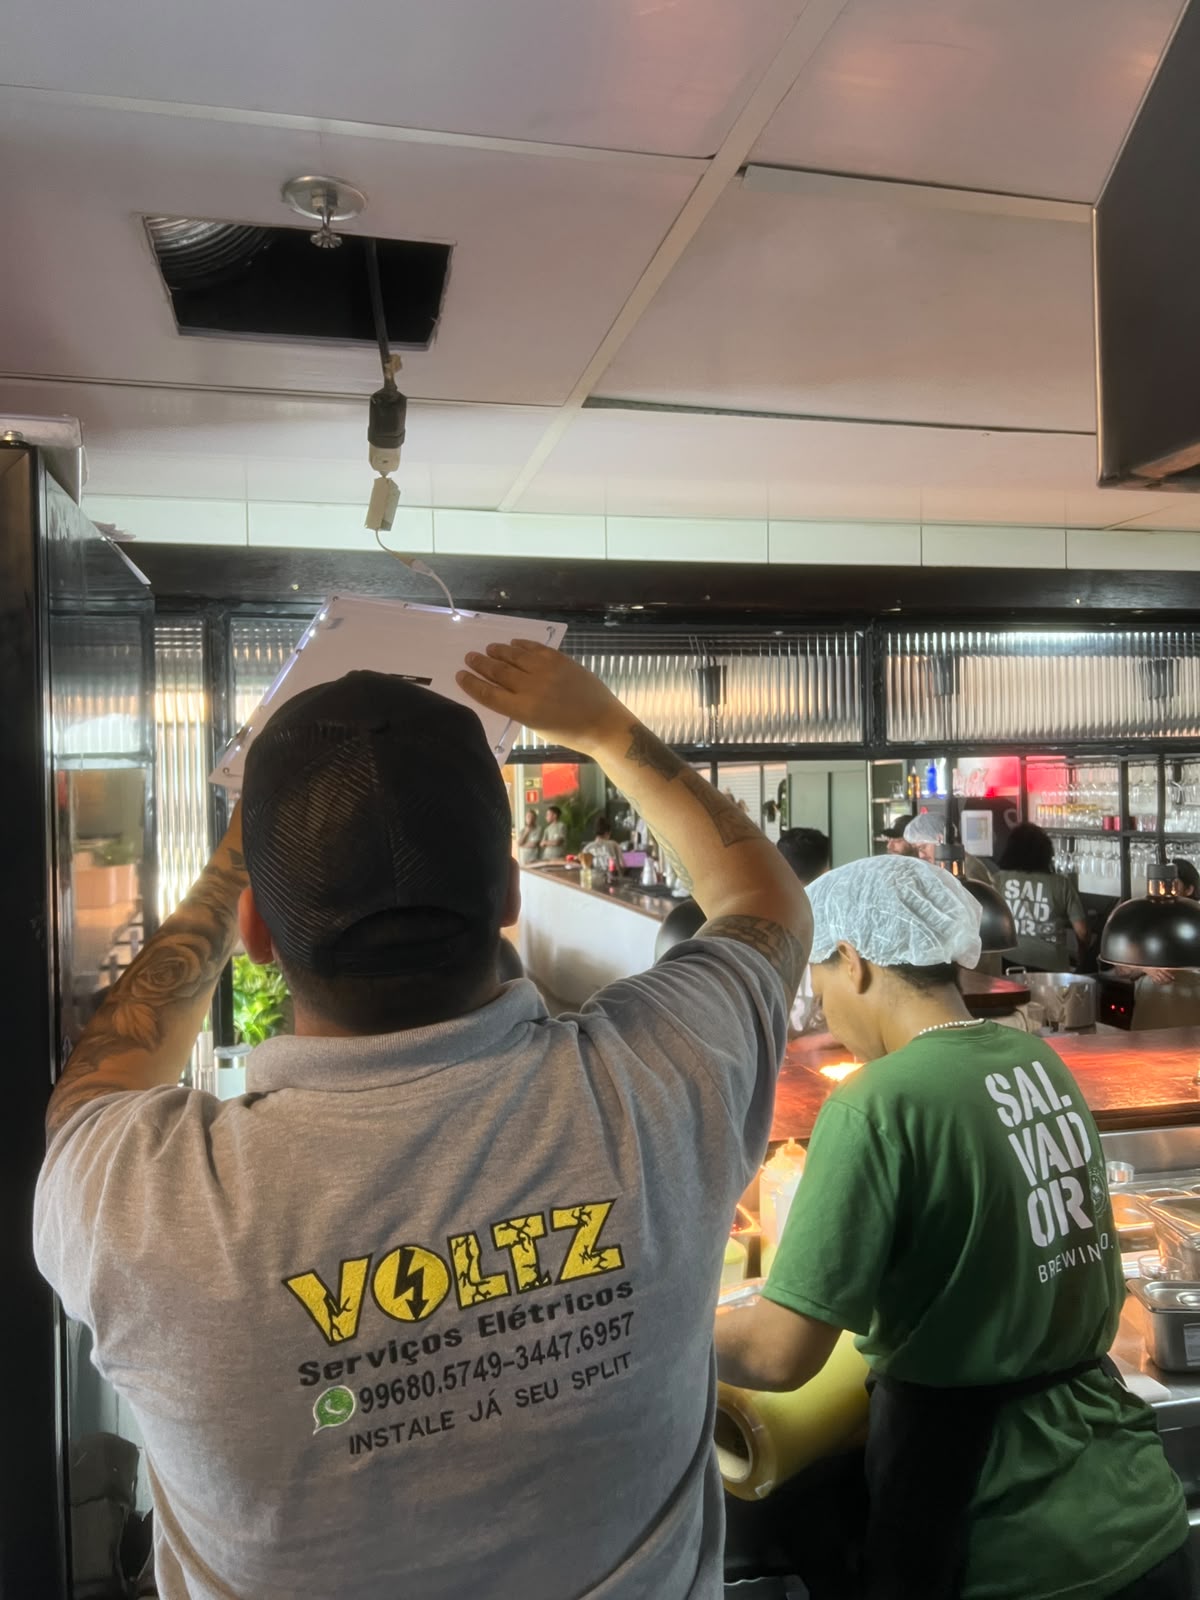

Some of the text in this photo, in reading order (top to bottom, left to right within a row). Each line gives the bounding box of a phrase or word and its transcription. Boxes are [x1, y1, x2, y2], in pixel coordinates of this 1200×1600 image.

[1004, 879, 1048, 903] SAL
[1005, 899, 1050, 922] VAD
[985, 1061, 1072, 1128] SAL
[1008, 1111, 1092, 1187] VAD
[1027, 1176, 1094, 1248] OR
[281, 1199, 625, 1347] VOLTZ
[298, 1280, 634, 1387] Serviços Elétricos
[349, 1351, 632, 1455] INSTALE JÁ SEU SPLIT
